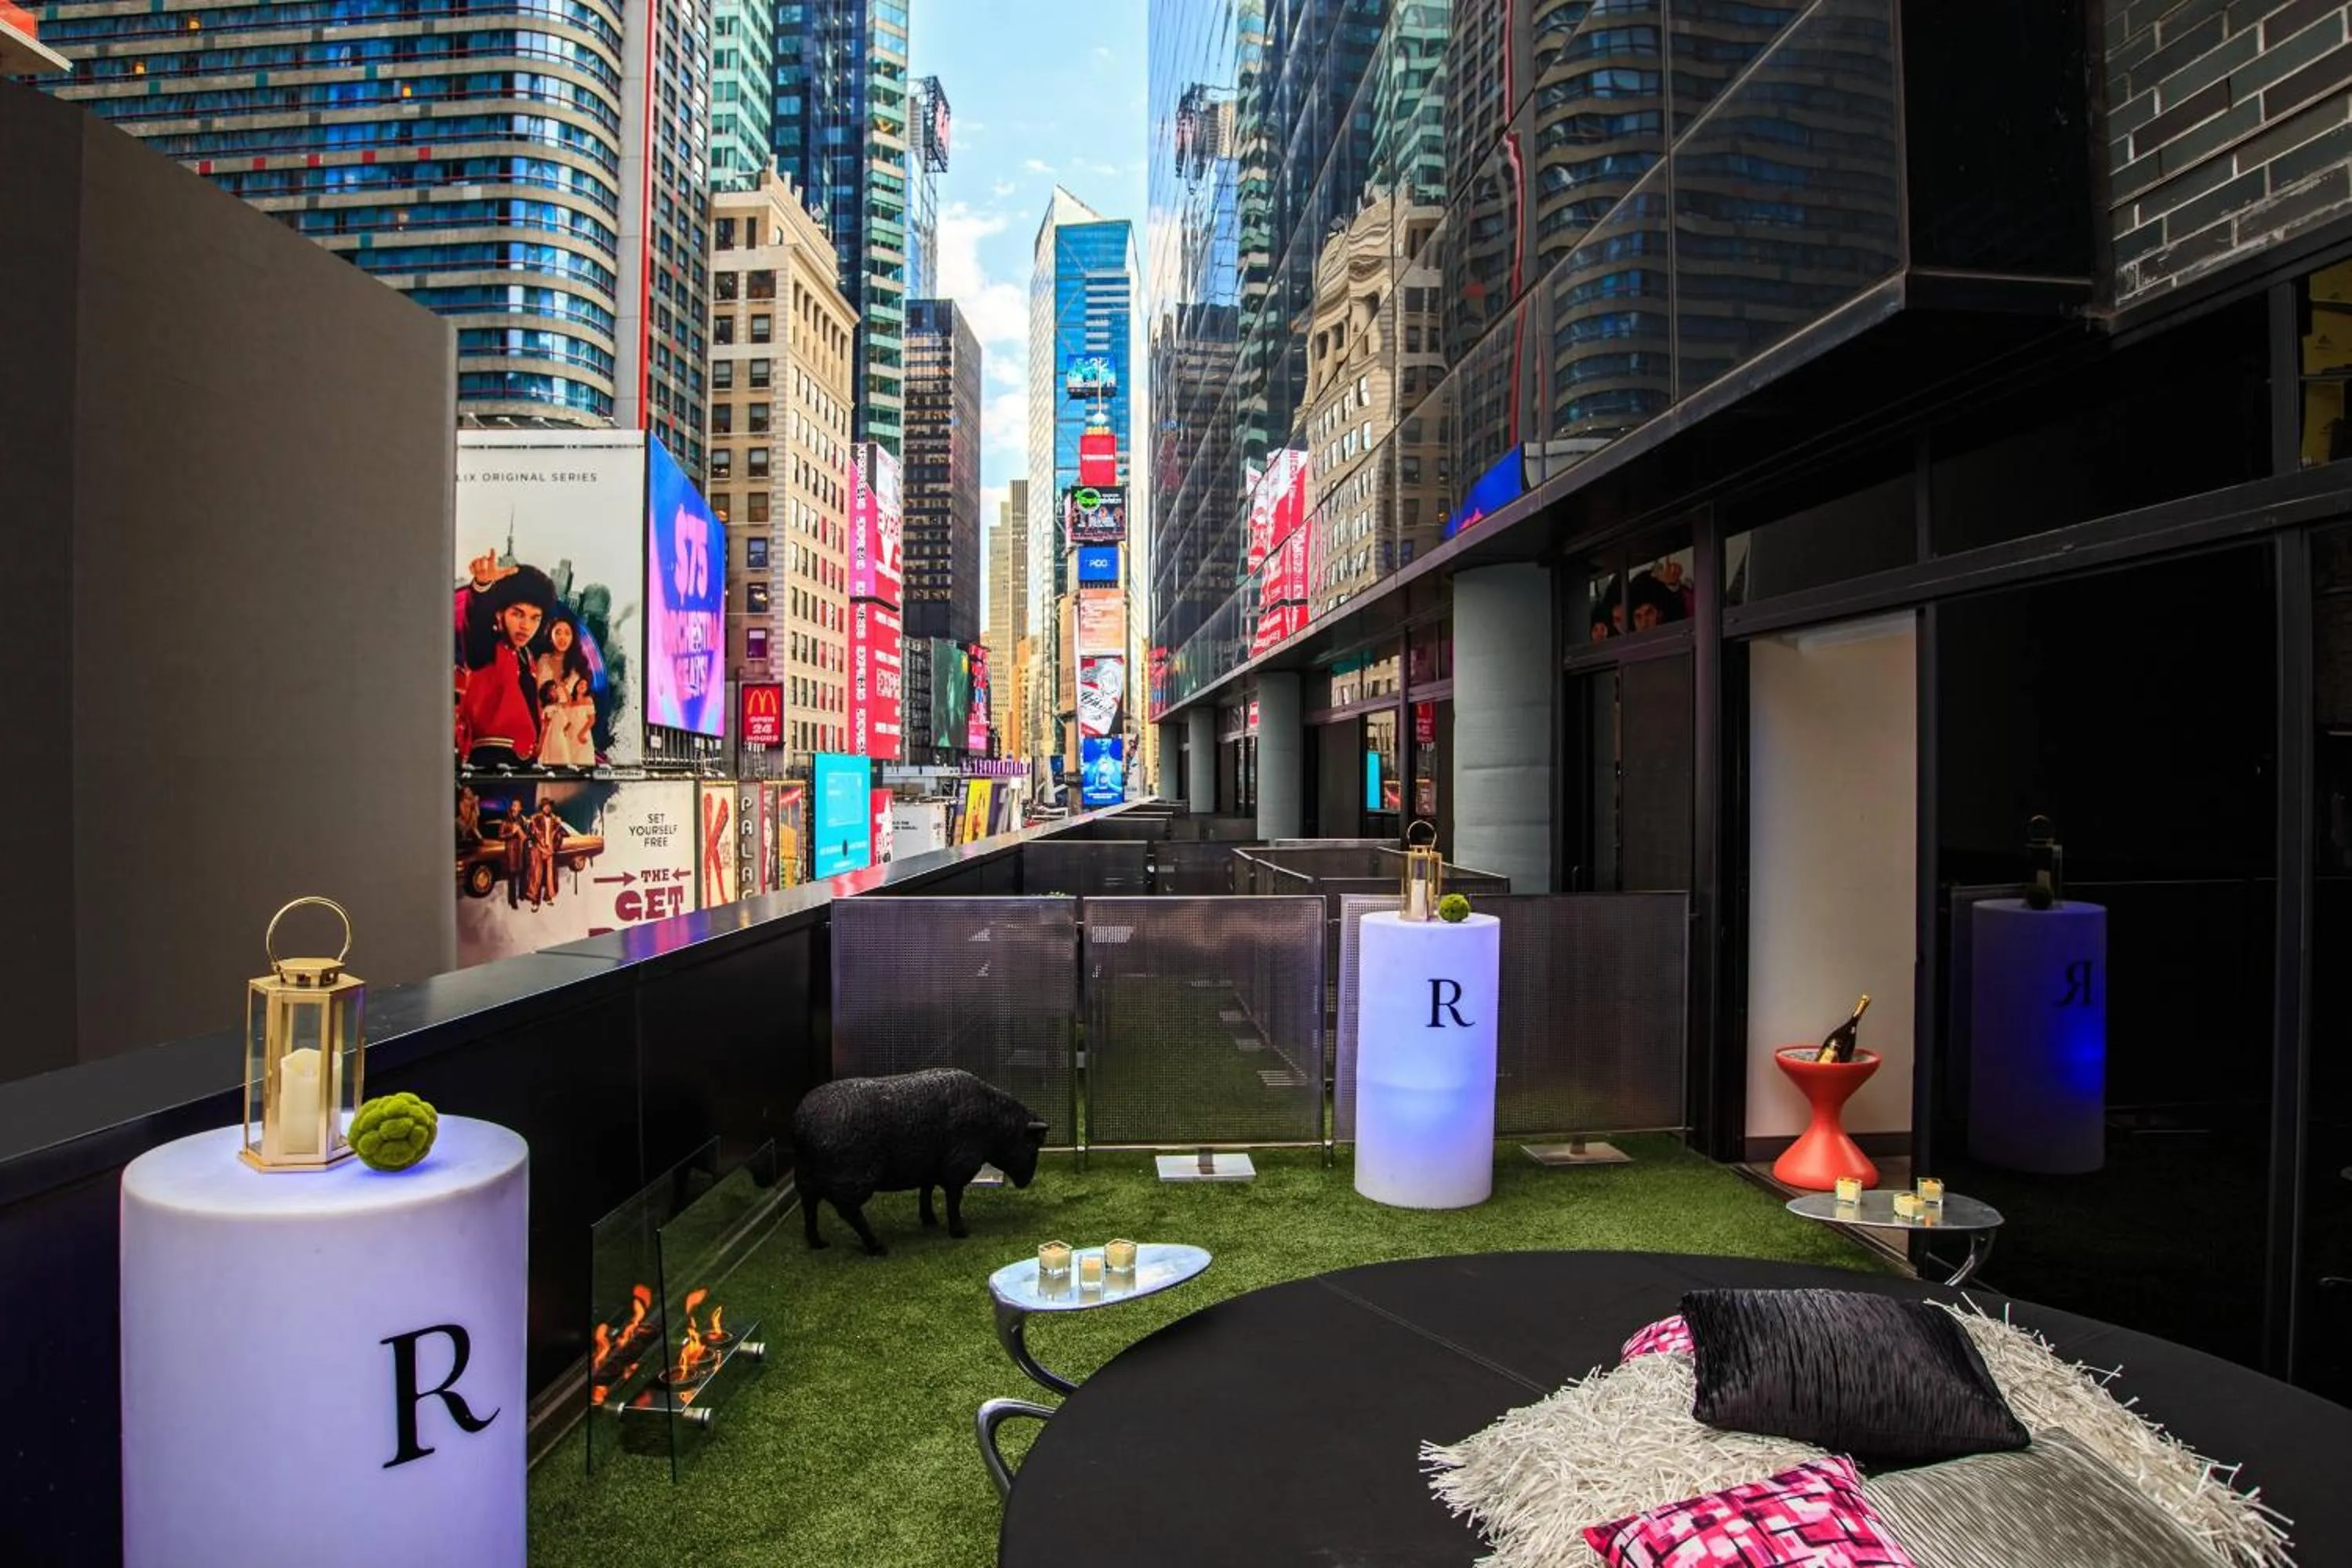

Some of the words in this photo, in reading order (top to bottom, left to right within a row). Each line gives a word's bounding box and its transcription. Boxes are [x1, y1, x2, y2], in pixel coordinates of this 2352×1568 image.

[482, 473, 546, 482] ORIGINAL
[551, 473, 597, 482] SERIES
[674, 503, 708, 606] $75
[752, 724, 772, 734] 24
[648, 813, 665, 823] SET
[629, 824, 678, 836] YOURSELF
[644, 837, 668, 848] FREE
[641, 868, 670, 883] THE
[615, 886, 684, 922] GET
[1425, 978, 1475, 1028] R
[379, 1323, 501, 1468] R
